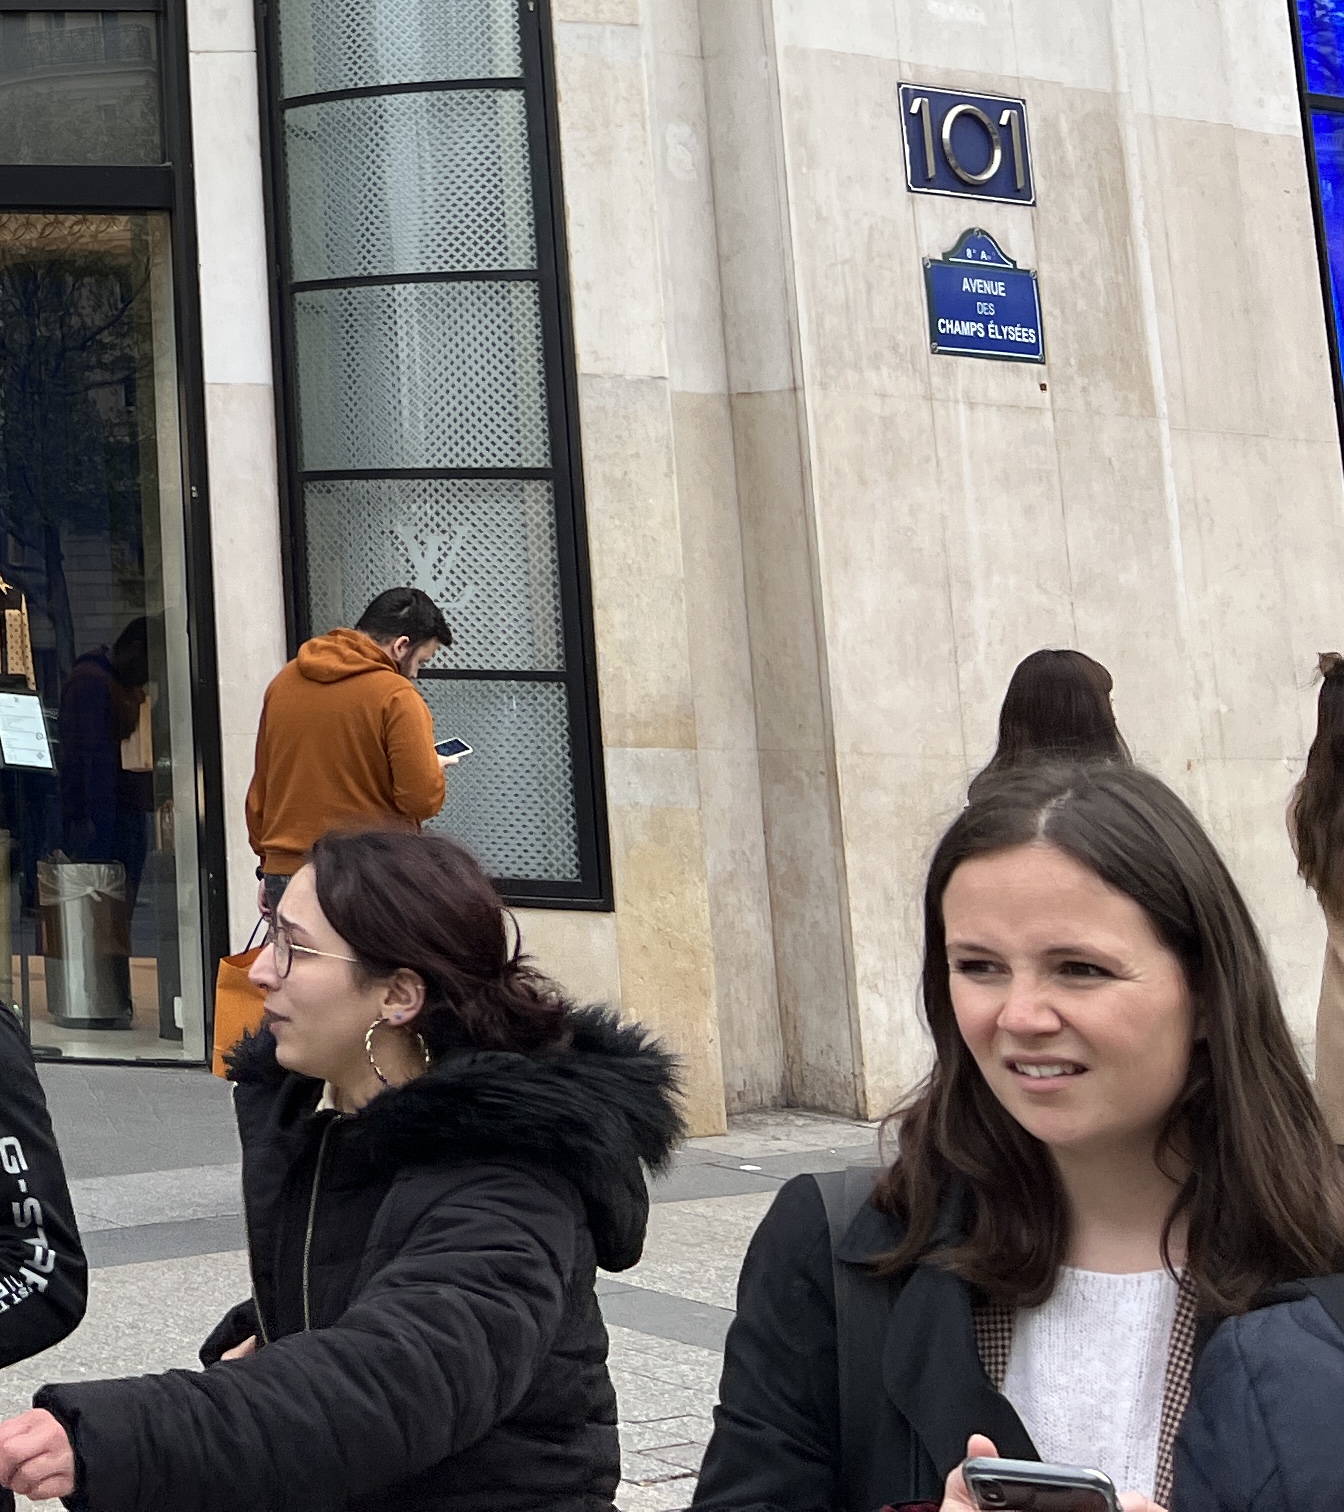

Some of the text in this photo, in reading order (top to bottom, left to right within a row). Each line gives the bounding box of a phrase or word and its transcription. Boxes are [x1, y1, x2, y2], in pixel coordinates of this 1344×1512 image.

[910, 97, 1025, 192] 101
[962, 277, 1006, 297] AVENUE
[977, 301, 995, 316] DES
[937, 318, 1036, 344] CHAMPS ÉLYSÉES
